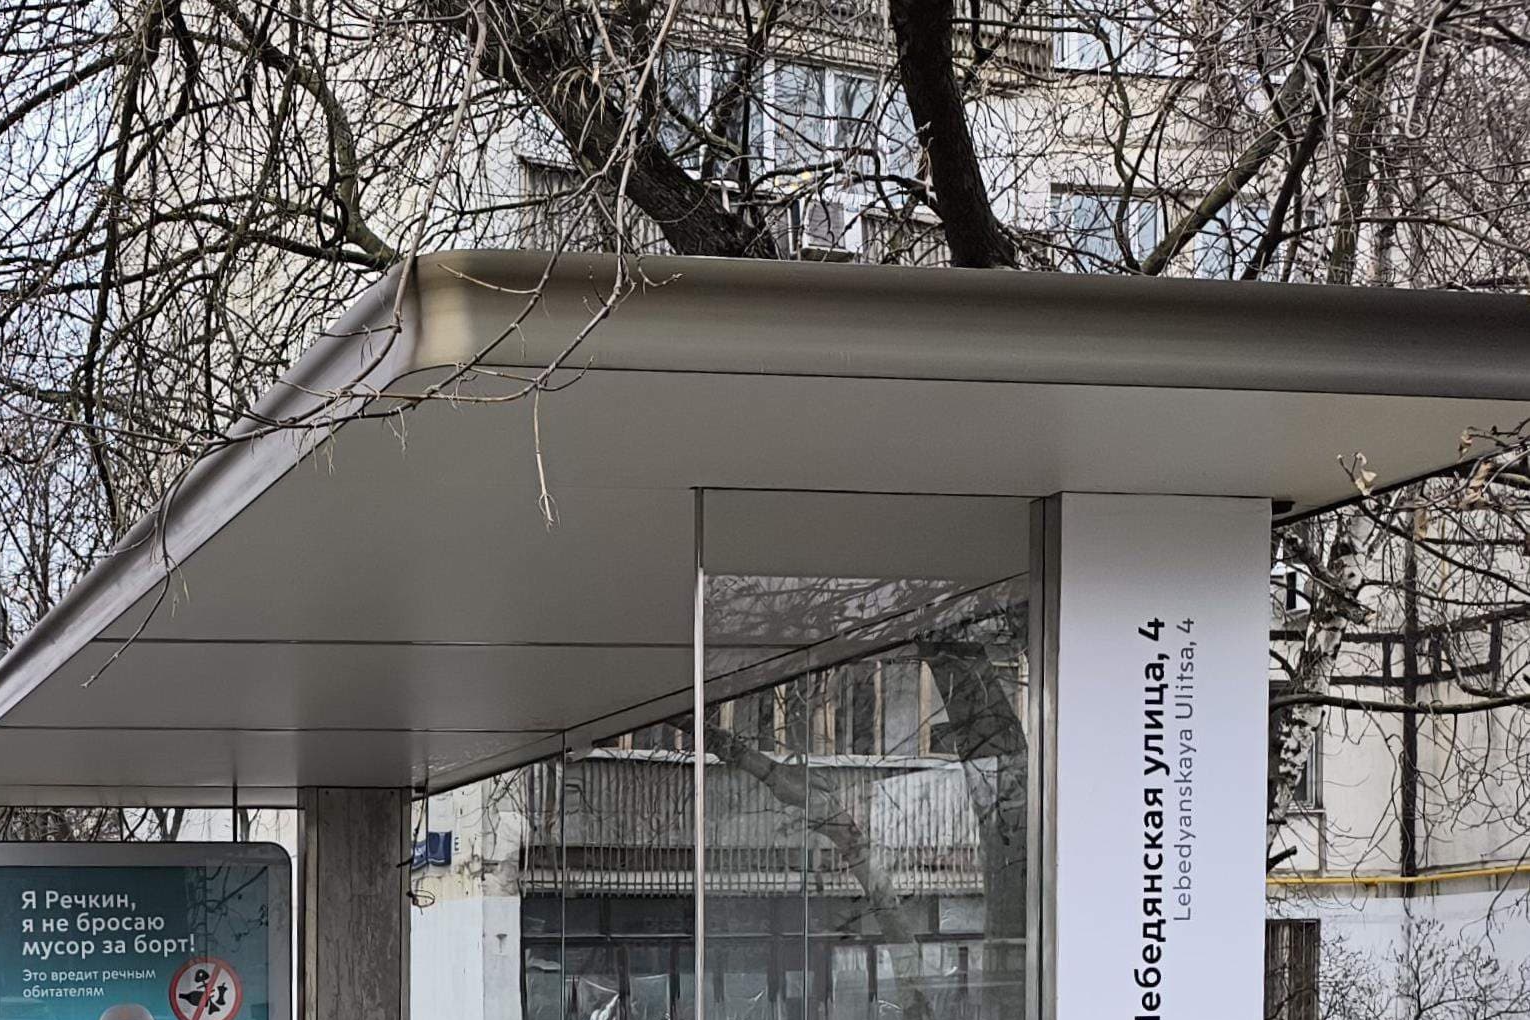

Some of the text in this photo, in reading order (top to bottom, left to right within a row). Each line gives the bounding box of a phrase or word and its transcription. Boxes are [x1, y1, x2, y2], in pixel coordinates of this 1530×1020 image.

[1138, 617, 1165, 641] 4
[1144, 653, 1170, 776] улица,
[1173, 618, 1197, 921] Lebedyanskaya Ulitsa, 4
[21, 890, 137, 911] Я Речкин,
[22, 912, 165, 936] я не бросаю
[22, 933, 196, 960] мусор за борт!
[22, 969, 156, 983] Это вредит речным
[23, 985, 104, 998] обитателям
